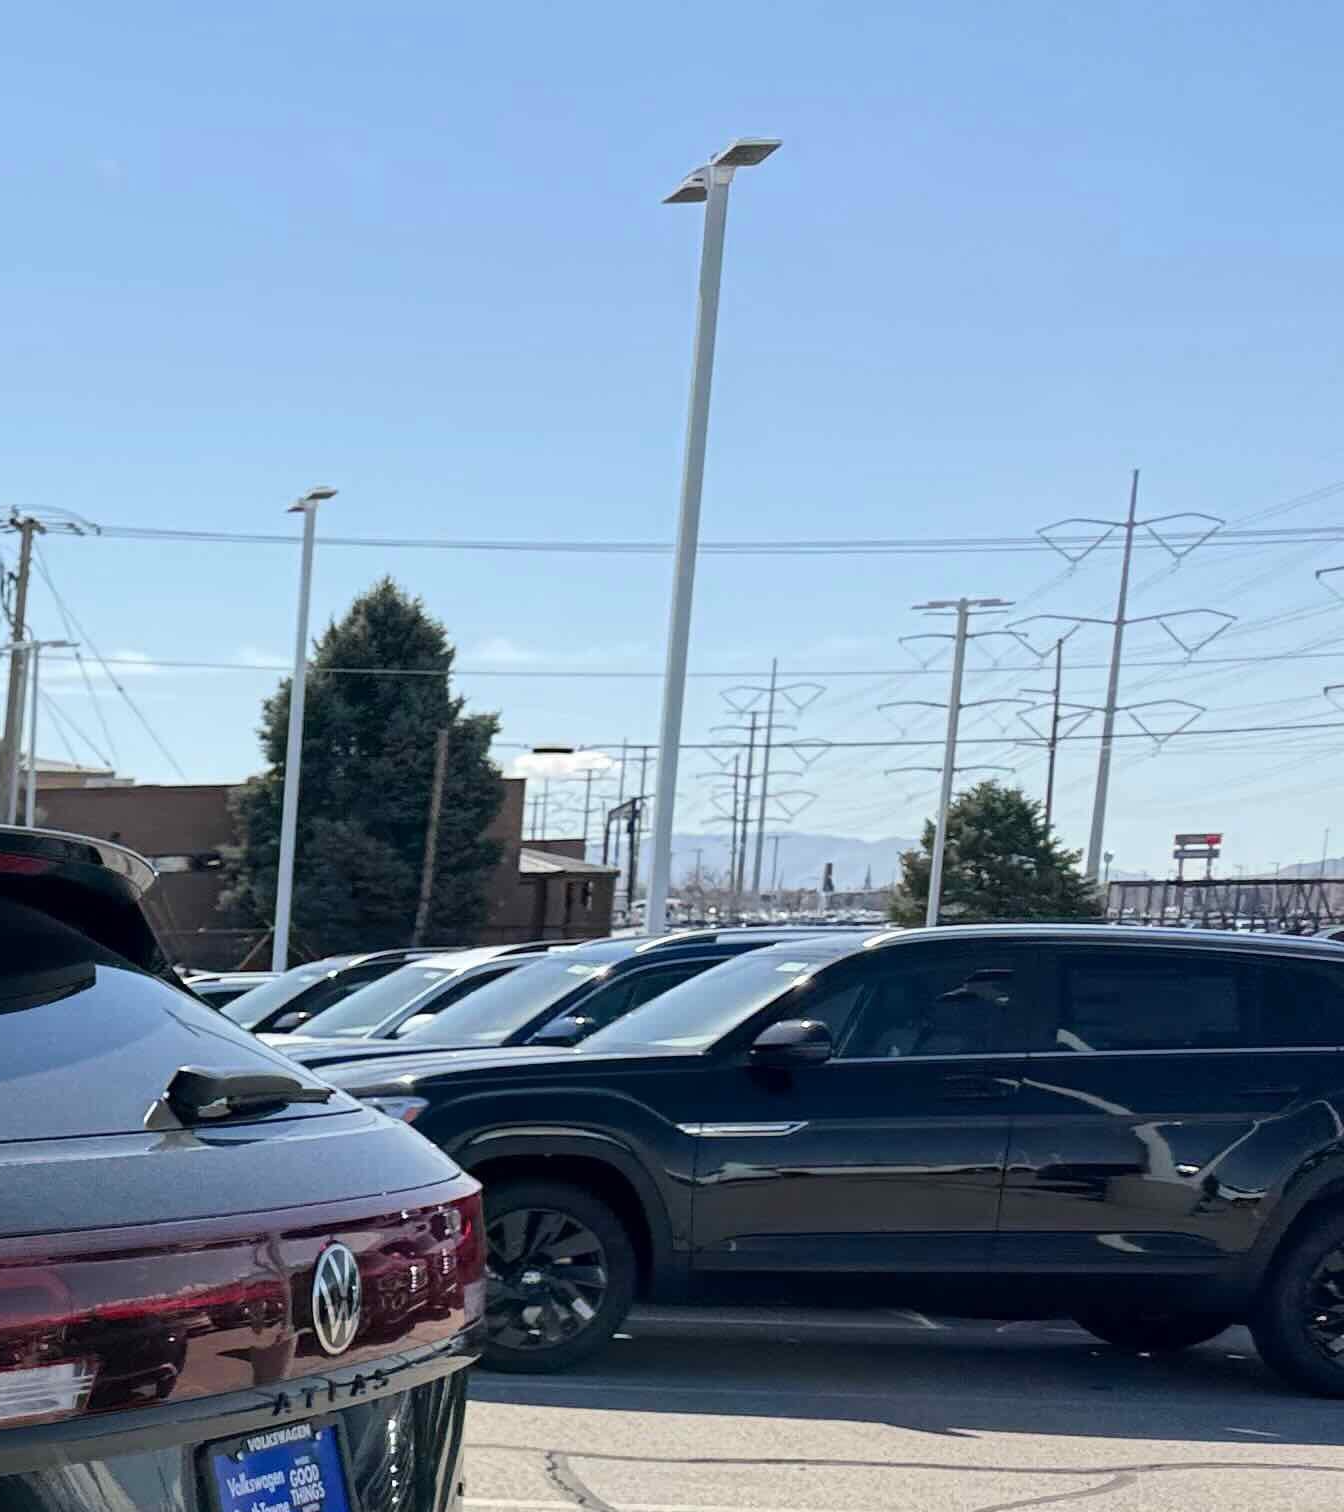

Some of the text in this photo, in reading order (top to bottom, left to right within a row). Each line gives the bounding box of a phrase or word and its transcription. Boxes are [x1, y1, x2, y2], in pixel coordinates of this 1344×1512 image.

[247, 1423, 311, 1452] VOLKSWAGEN
[227, 1470, 286, 1497] Volkswagen
[289, 1464, 320, 1488] GOOD
[290, 1481, 326, 1507] THINGS
